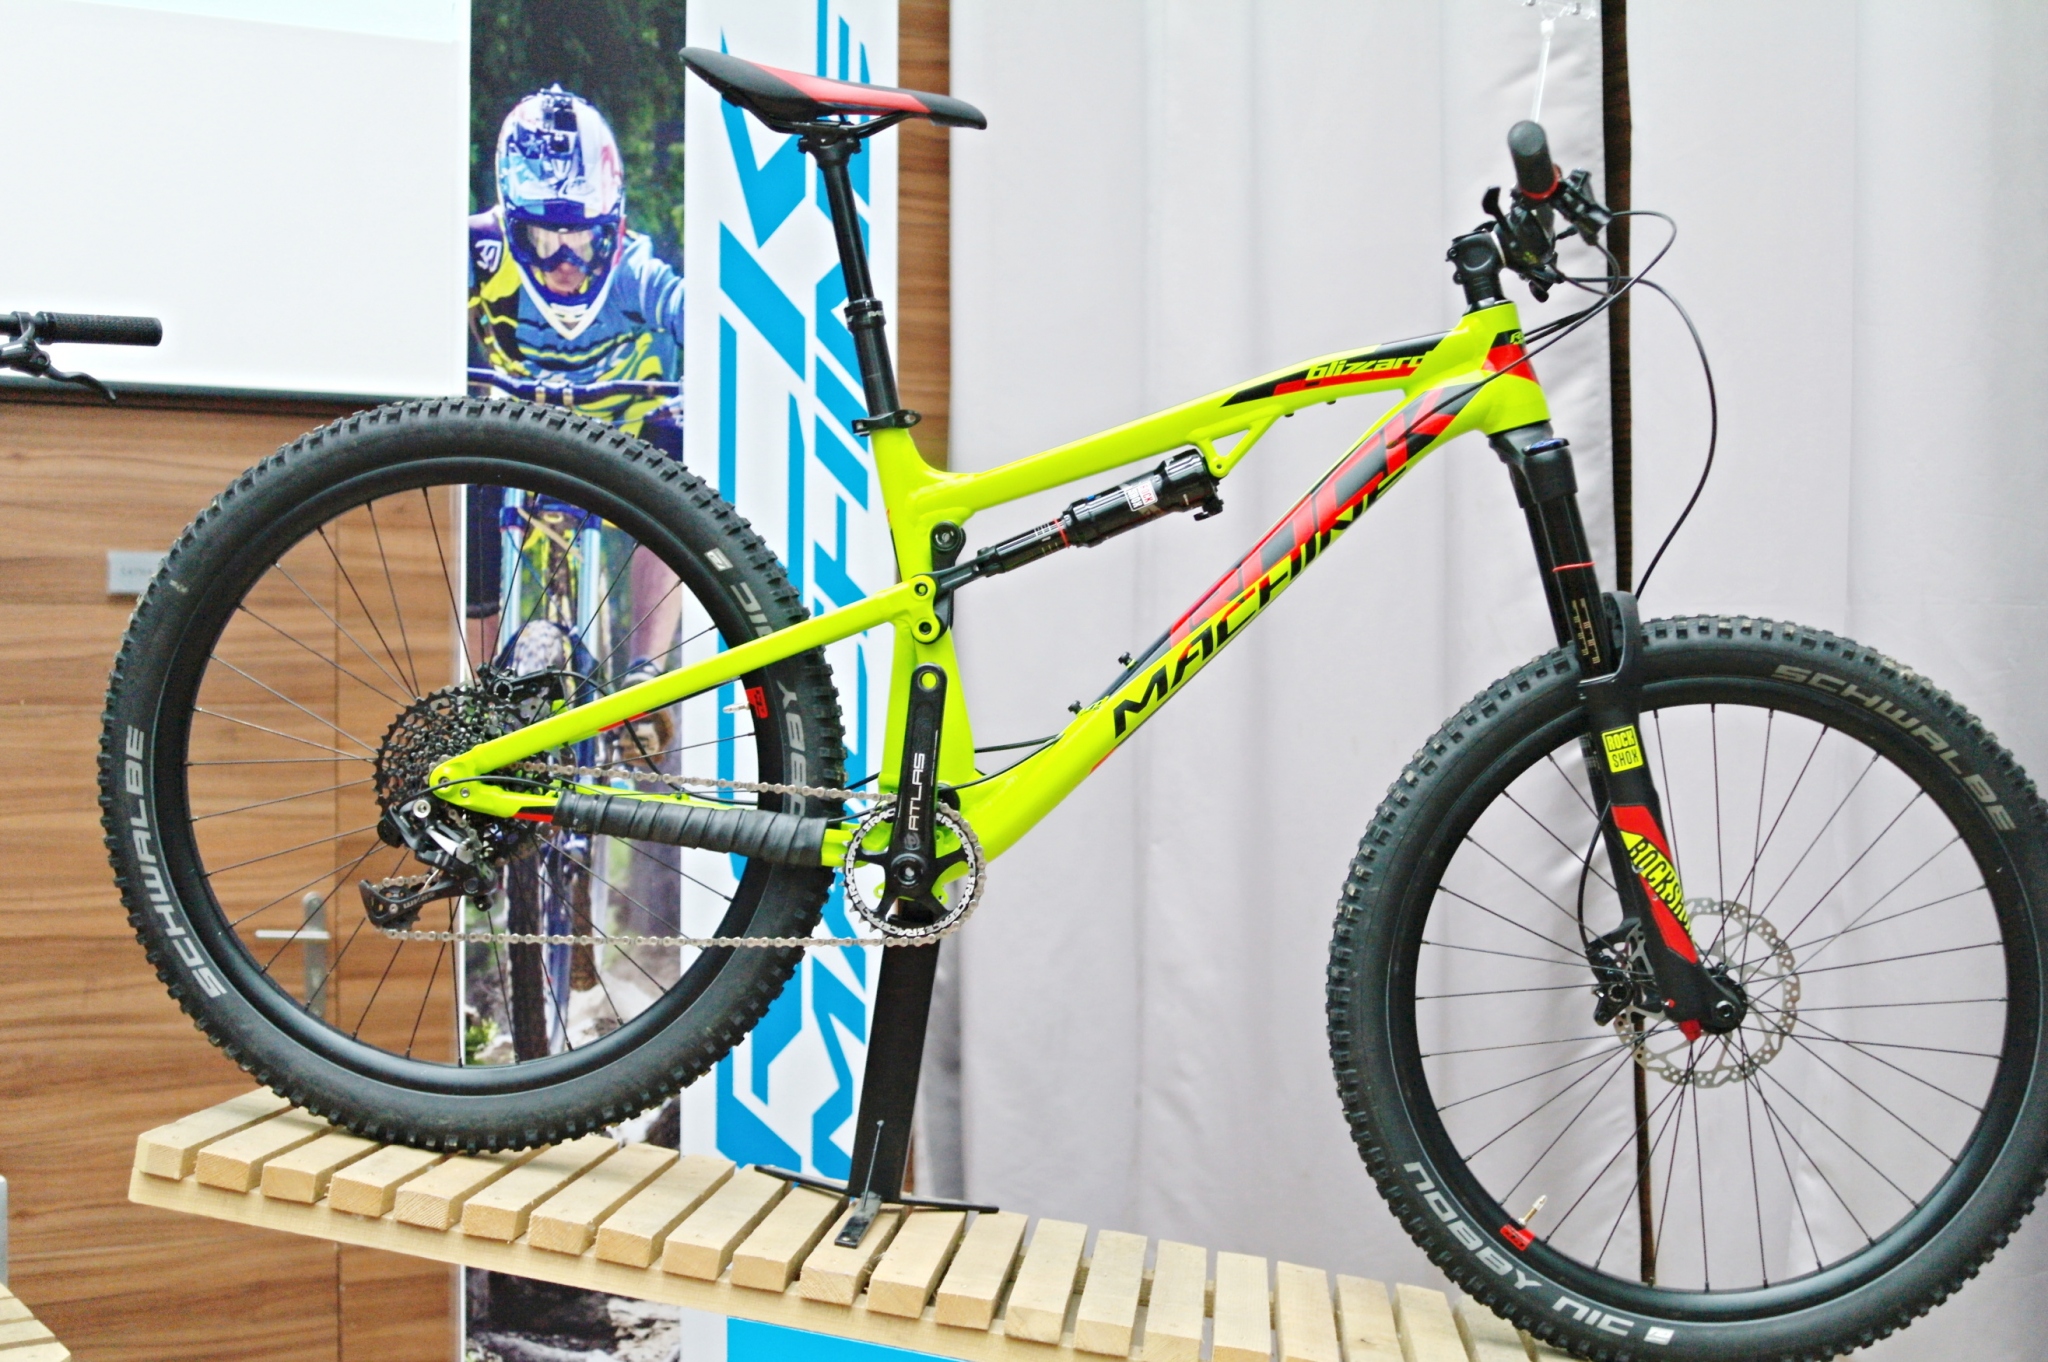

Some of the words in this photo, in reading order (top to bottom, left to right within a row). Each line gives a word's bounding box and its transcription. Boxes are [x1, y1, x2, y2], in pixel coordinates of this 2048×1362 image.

[1605, 730, 1635, 751] ROCK
[1612, 749, 1639, 768] SHOX
[1771, 664, 2016, 830] SCHWALBE
[908, 752, 925, 831] ATLAS
[125, 725, 227, 998] SCHWALBE
